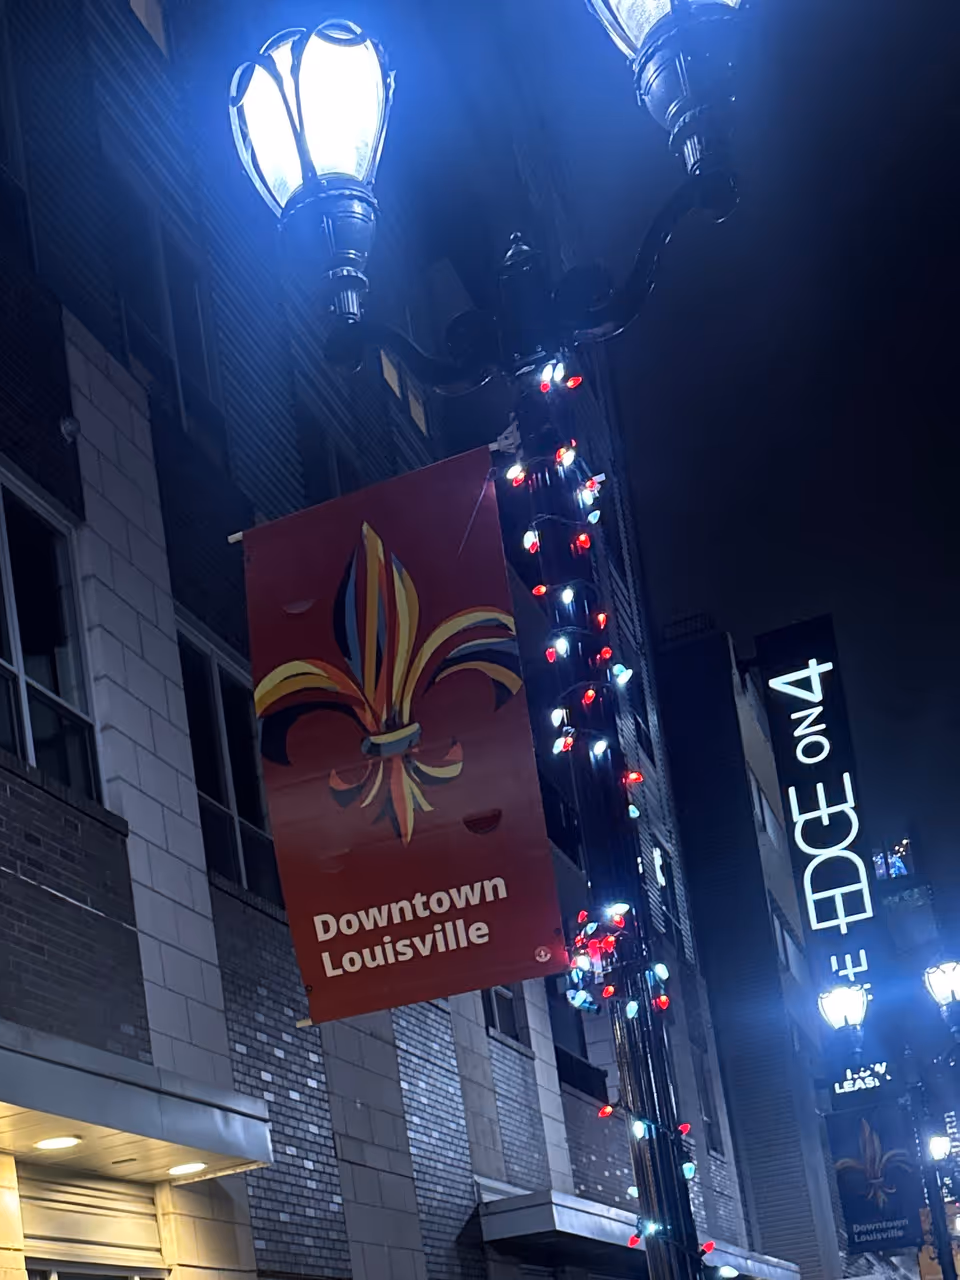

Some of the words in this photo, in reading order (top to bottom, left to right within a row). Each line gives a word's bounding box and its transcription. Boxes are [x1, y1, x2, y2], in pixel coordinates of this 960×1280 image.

[768, 658, 833, 703] 4
[791, 705, 830, 764] ON
[788, 772, 873, 934] EDGE
[313, 875, 508, 942] Downtown
[321, 918, 489, 978] Louisville
[853, 1218, 908, 1233] Downtown
[855, 1228, 904, 1242] Louisville
